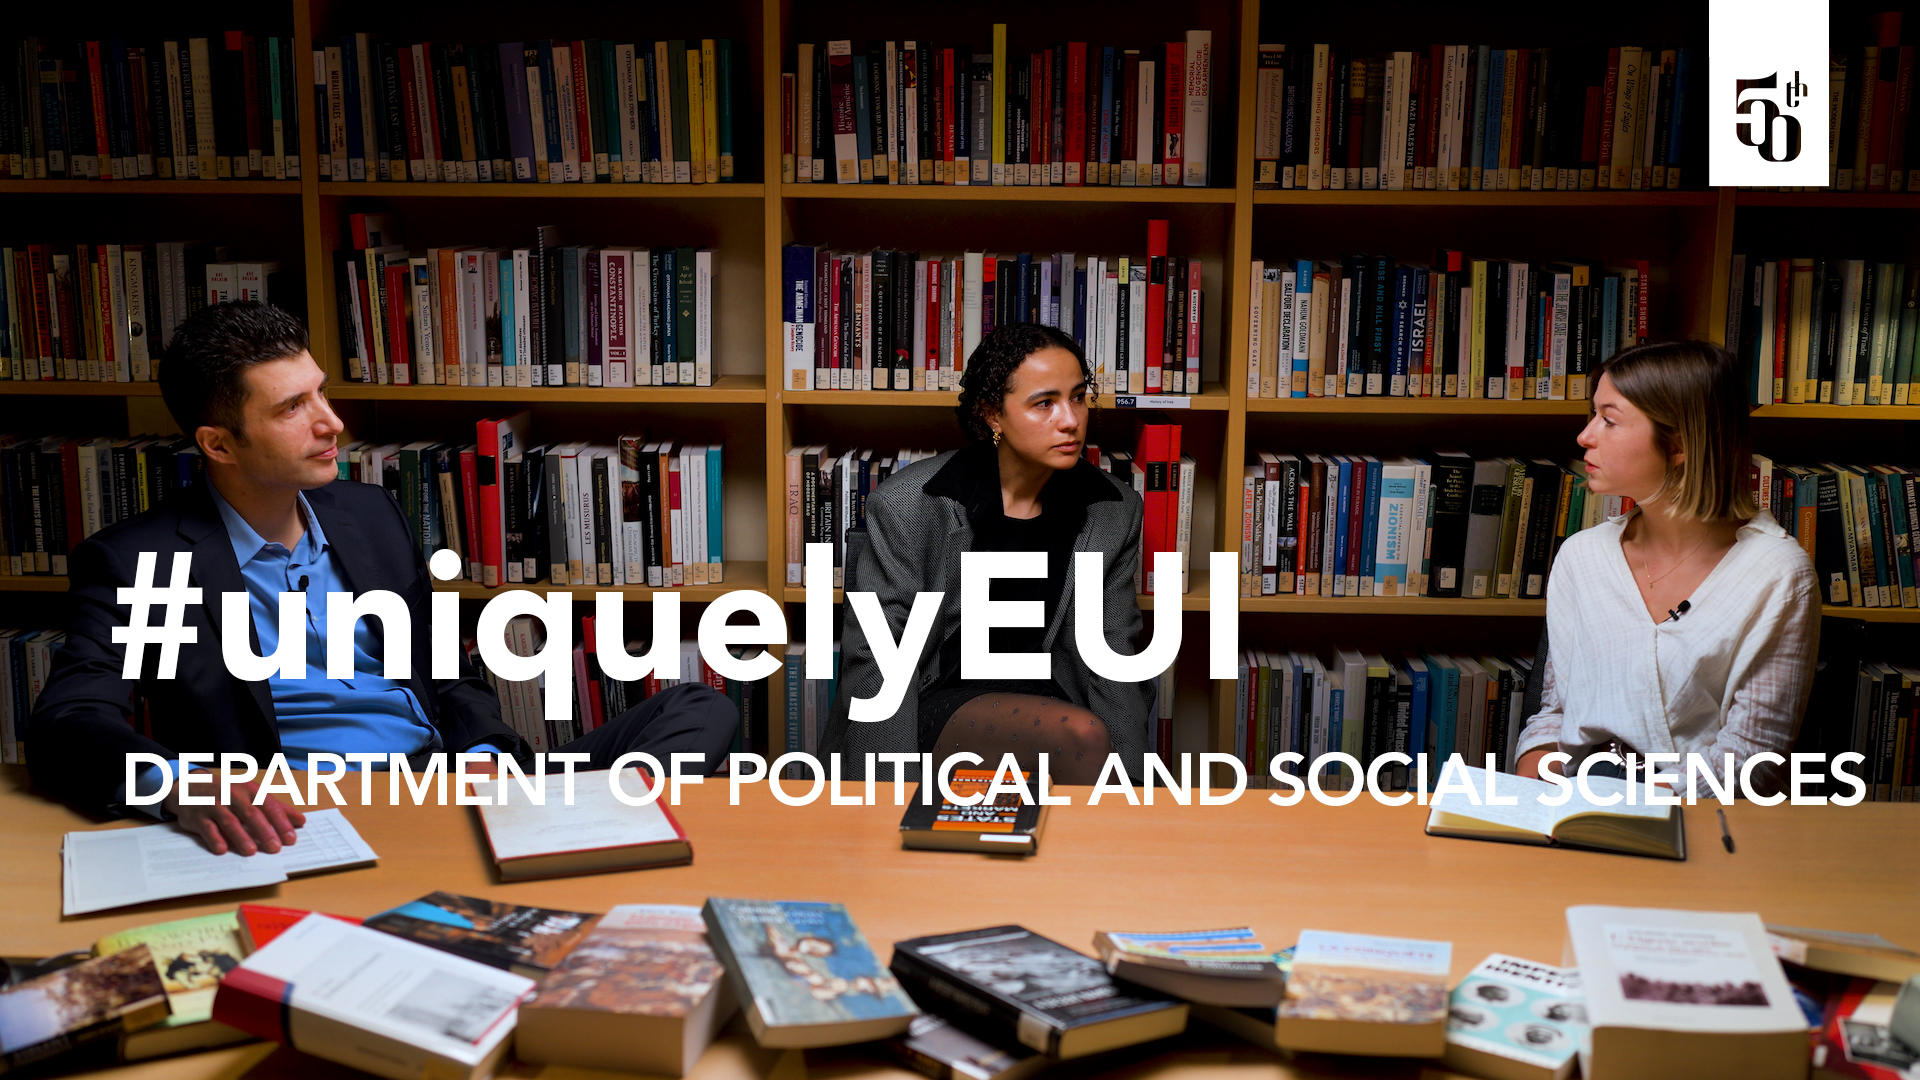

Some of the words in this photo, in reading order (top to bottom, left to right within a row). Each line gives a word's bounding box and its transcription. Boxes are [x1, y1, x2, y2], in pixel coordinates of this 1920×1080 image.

[385, 56, 398, 103] CREATING
[1195, 85, 1202, 96] DU
[184, 99, 194, 120] BELL
[1315, 82, 1323, 113] DEFINING
[1409, 99, 1417, 120] NAZI
[837, 102, 845, 132] Histoire
[1406, 123, 1416, 167] PALESTINE
[1377, 260, 1387, 281] RISE
[128, 257, 141, 316] KINGMAKERS
[795, 280, 804, 291] THE
[864, 283, 870, 294] WE
[1376, 283, 1385, 302] AND
[1640, 273, 1648, 294] STATE
[608, 262, 617, 341] CONSTANTINOPLE
[795, 292, 804, 323] ARMENIAN
[1283, 282, 1293, 310] BALFOUR
[1558, 293, 1569, 302] THE
[1640, 296, 1647, 305] OF
[422, 305, 431, 331] Sultan's
[1299, 299, 1308, 320] NAHUM
[1375, 304, 1384, 325] KILL
[1639, 306, 1647, 330] SHOCK
[651, 314, 659, 336] Turkey
[877, 326, 883, 335] OF
[1251, 305, 1259, 346] GOVERNING
[1282, 311, 1292, 351] DECLARATION
[1298, 321, 1307, 353] GOLDMANN
[1412, 299, 1427, 352] ISRAEL
[1860, 326, 1870, 334] of
[424, 332, 432, 356] Yemen
[795, 324, 804, 352] GENOCIDE
[1373, 327, 1383, 353] FIRST
[1860, 335, 1869, 356] Trade
[1397, 347, 1402, 356] OF
[1115, 397, 1135, 406] 956.7
[118, 453, 126, 480] EMPIRES
[32, 485, 40, 497] THE
[1256, 483, 1264, 494] The
[1288, 467, 1296, 495] ACROSS
[1761, 475, 1770, 501] CULTURES
[789, 483, 799, 515] IRAQ
[1245, 488, 1253, 509] AFTER
[1255, 495, 1263, 522] Palestine
[1287, 497, 1295, 510] THE
[34, 518, 42, 527] OF
[582, 492, 591, 530] MUSURUS
[824, 501, 832, 533] BRITAIN
[1286, 512, 1294, 532] WALL
[422, 514, 431, 545] NATION
[584, 532, 592, 545] LES
[1244, 512, 1252, 542] ZIONISM
[1254, 523, 1262, 542] Nakba
[1386, 503, 1398, 560] ZIONISM
[1848, 532, 1857, 572] MYANMAR
[789, 666, 798, 679] THE
[789, 681, 798, 720] DAMASCUS
[1891, 690, 1901, 704] The
